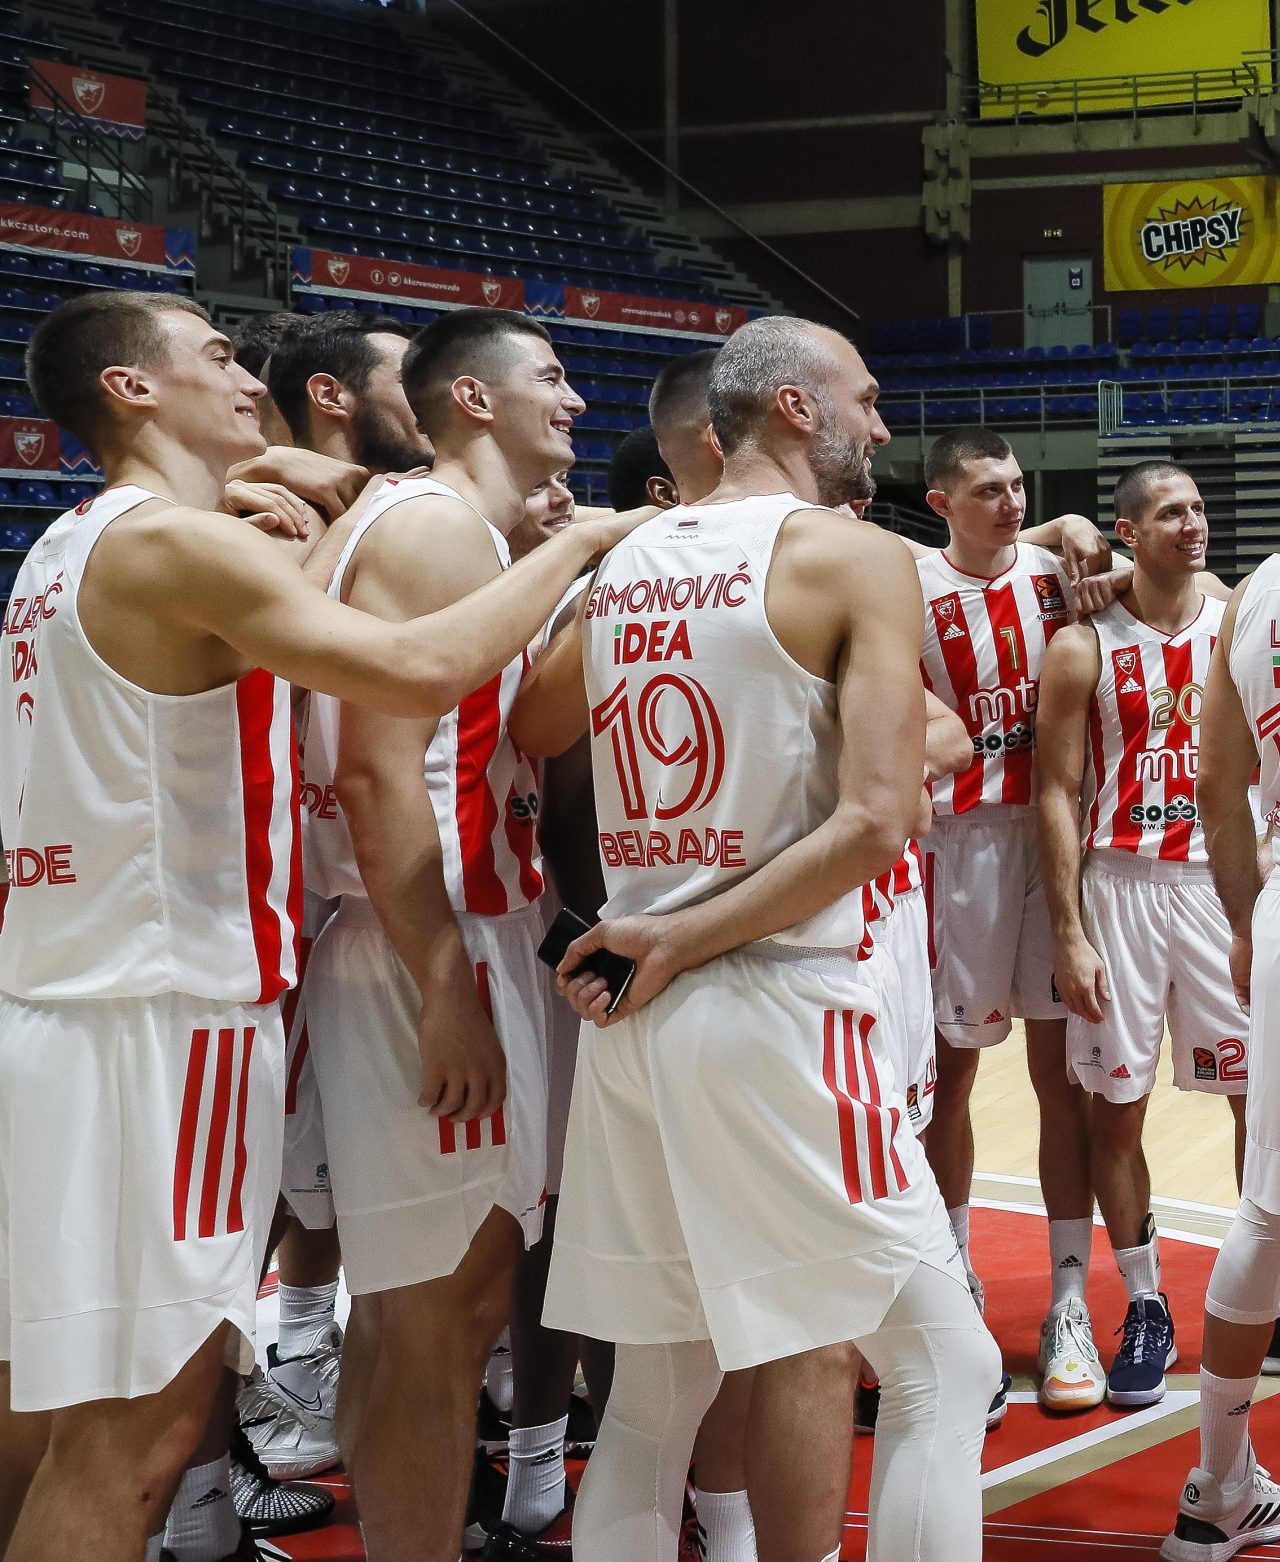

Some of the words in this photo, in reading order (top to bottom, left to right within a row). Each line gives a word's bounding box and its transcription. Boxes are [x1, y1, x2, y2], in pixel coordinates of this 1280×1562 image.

[585, 561, 752, 620] SIMONOVIĆ
[999, 626, 1020, 670] 1
[969, 676, 1036, 722] mt
[1150, 682, 1204, 731] 20
[591, 672, 725, 821] 19
[1135, 740, 1199, 782] mt
[1216, 1038, 1248, 1082] 2
